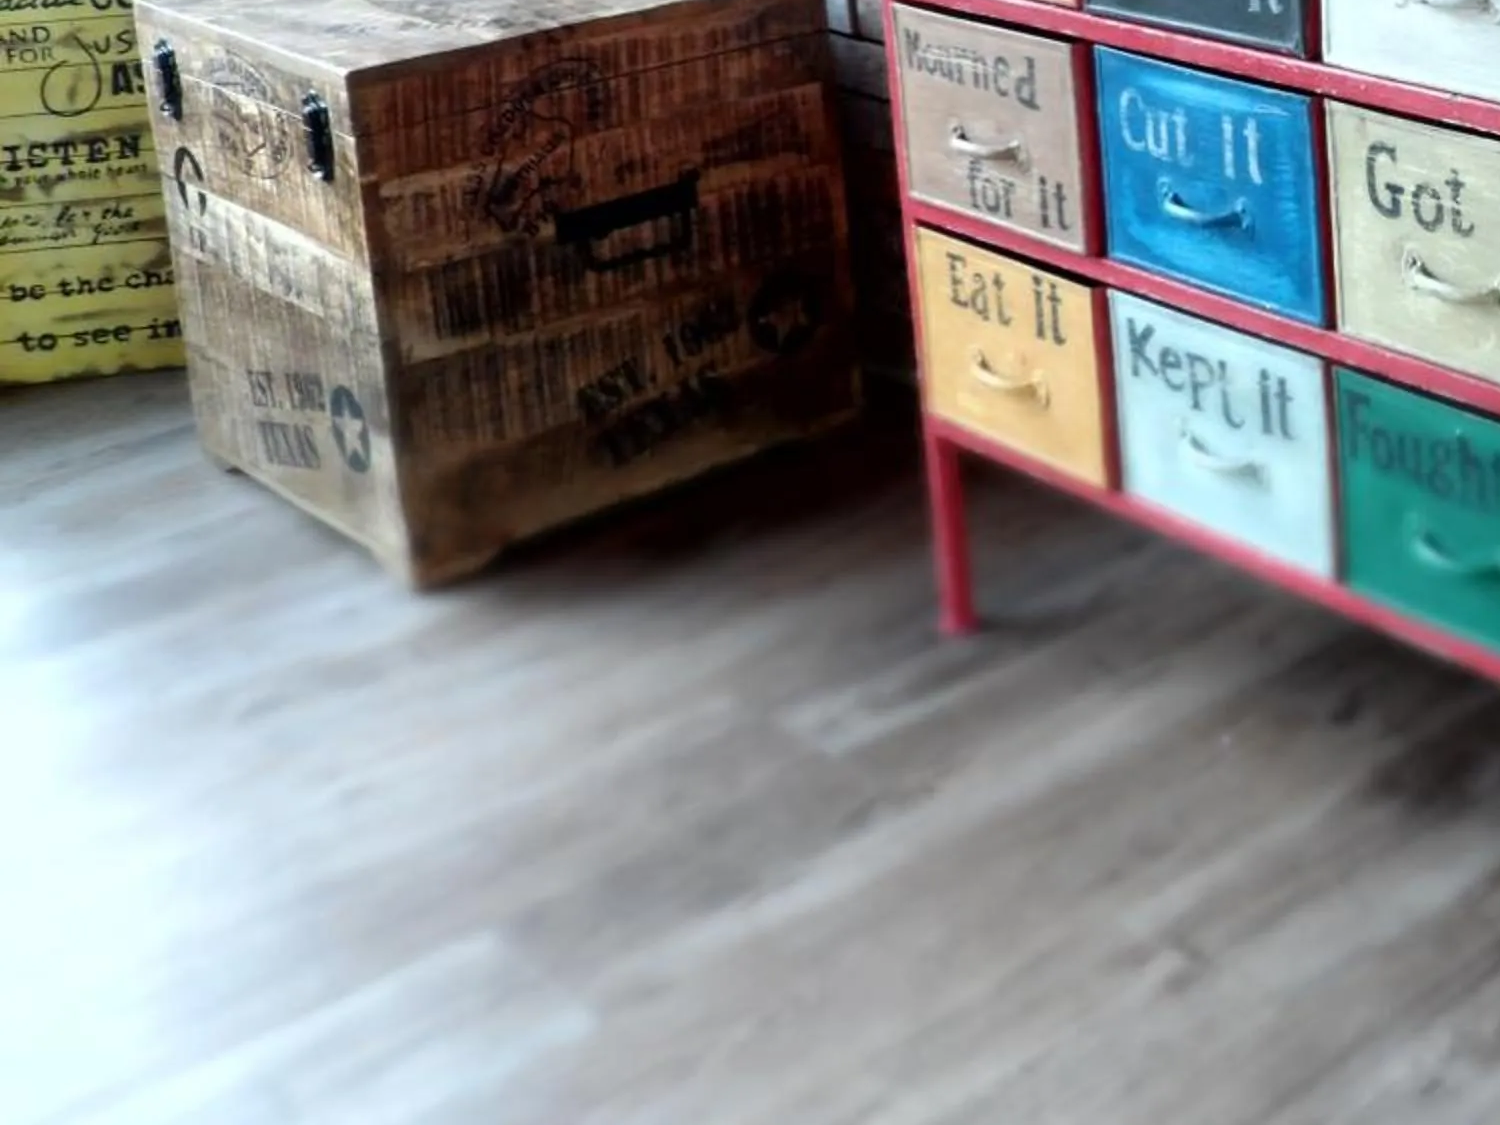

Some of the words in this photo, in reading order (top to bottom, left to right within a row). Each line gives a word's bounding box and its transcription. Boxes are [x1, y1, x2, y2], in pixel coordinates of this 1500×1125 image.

[6, 47, 56, 65] FOR
[904, 27, 1041, 112] Mourned
[3, 134, 142, 172] ISTEN
[1119, 86, 1195, 167] Cut
[967, 159, 1017, 219] for
[1040, 176, 1071, 232] it
[1365, 139, 1475, 239] Got
[9, 283, 47, 302] be
[58, 275, 116, 297] the
[946, 251, 1013, 327] Eat
[1032, 274, 1067, 346] it
[16, 331, 58, 353] to
[73, 324, 132, 347] see
[1126, 316, 1246, 431] Kept
[1257, 368, 1296, 442] it
